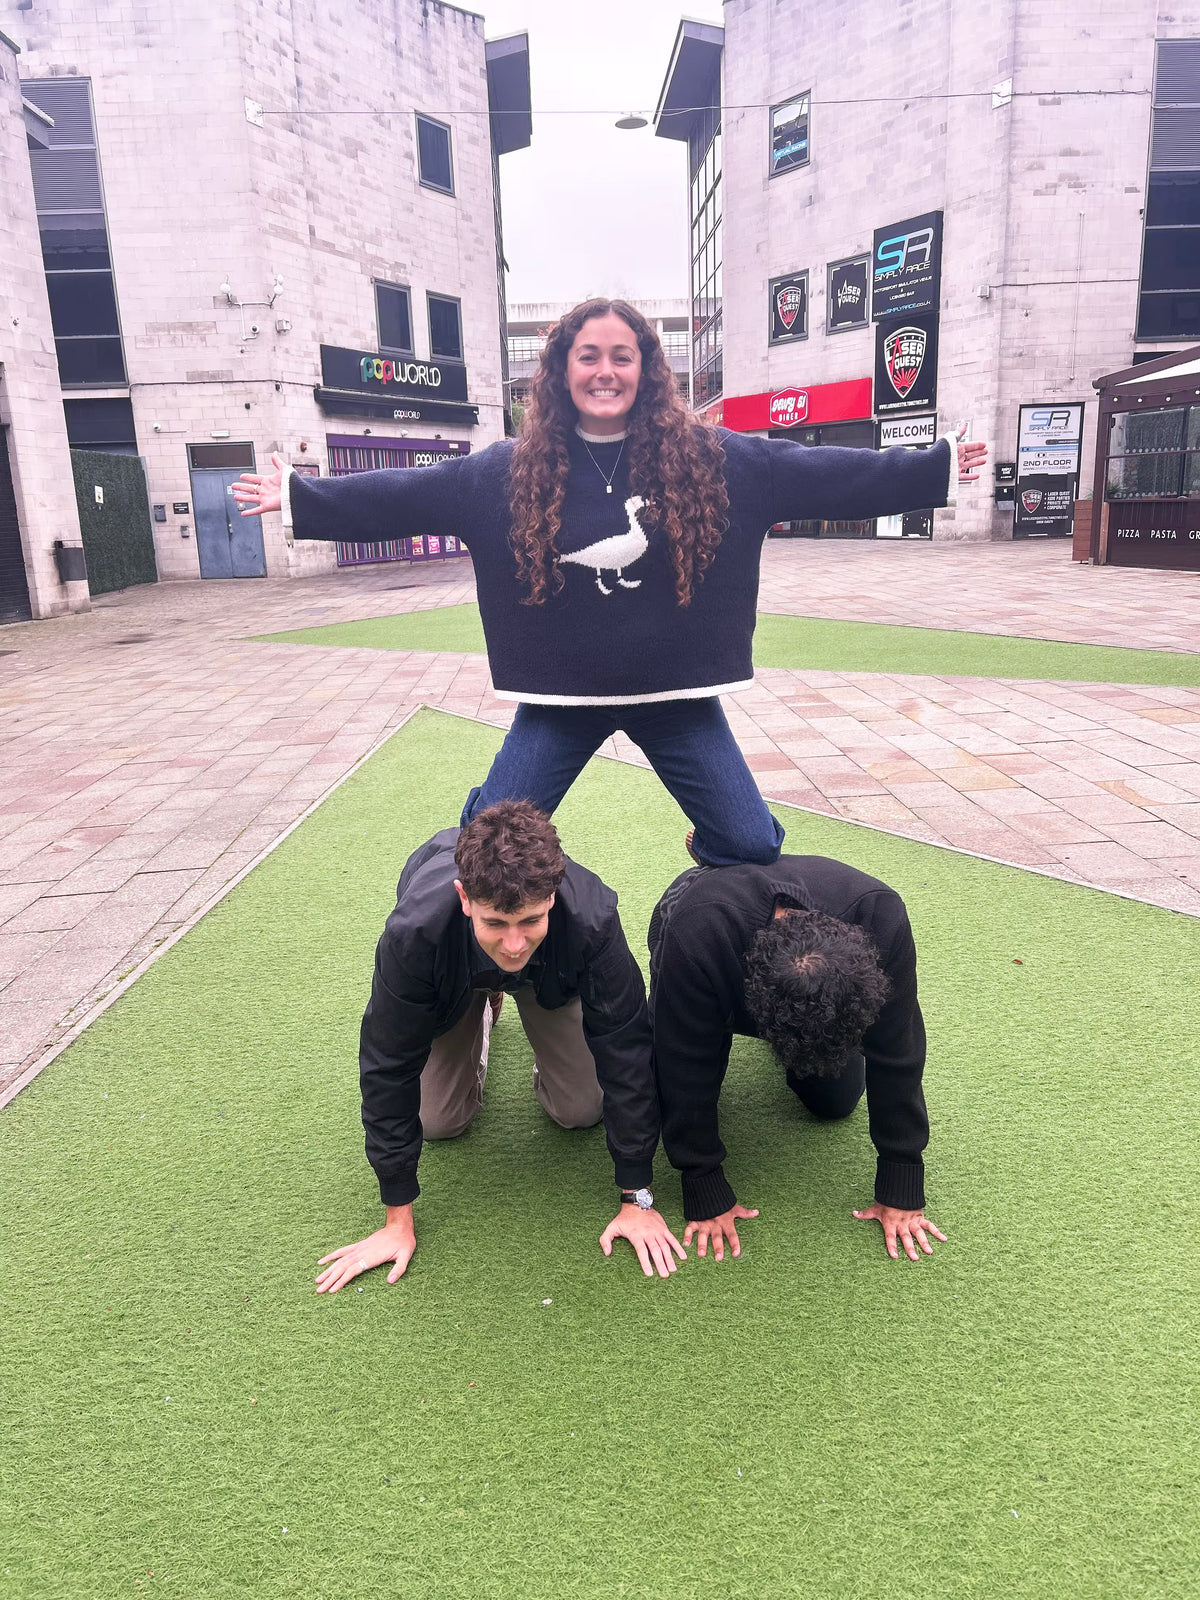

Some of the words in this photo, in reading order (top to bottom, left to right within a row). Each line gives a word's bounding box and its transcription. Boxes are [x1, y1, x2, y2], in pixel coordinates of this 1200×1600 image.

[875, 227, 934, 275] SR
[874, 266, 905, 282] SIMPLY
[905, 260, 931, 274] RACE
[838, 280, 861, 297] LASER
[778, 293, 800, 307] LASER
[782, 303, 799, 312] QUEST
[886, 335, 923, 361] LASER
[893, 355, 922, 370] QUEST
[778, 412, 799, 422] DINER
[1029, 410, 1071, 427] SR
[882, 423, 934, 439] WELCOME
[1117, 528, 1140, 538] PIZZA
[1150, 529, 1177, 539] PASTA
